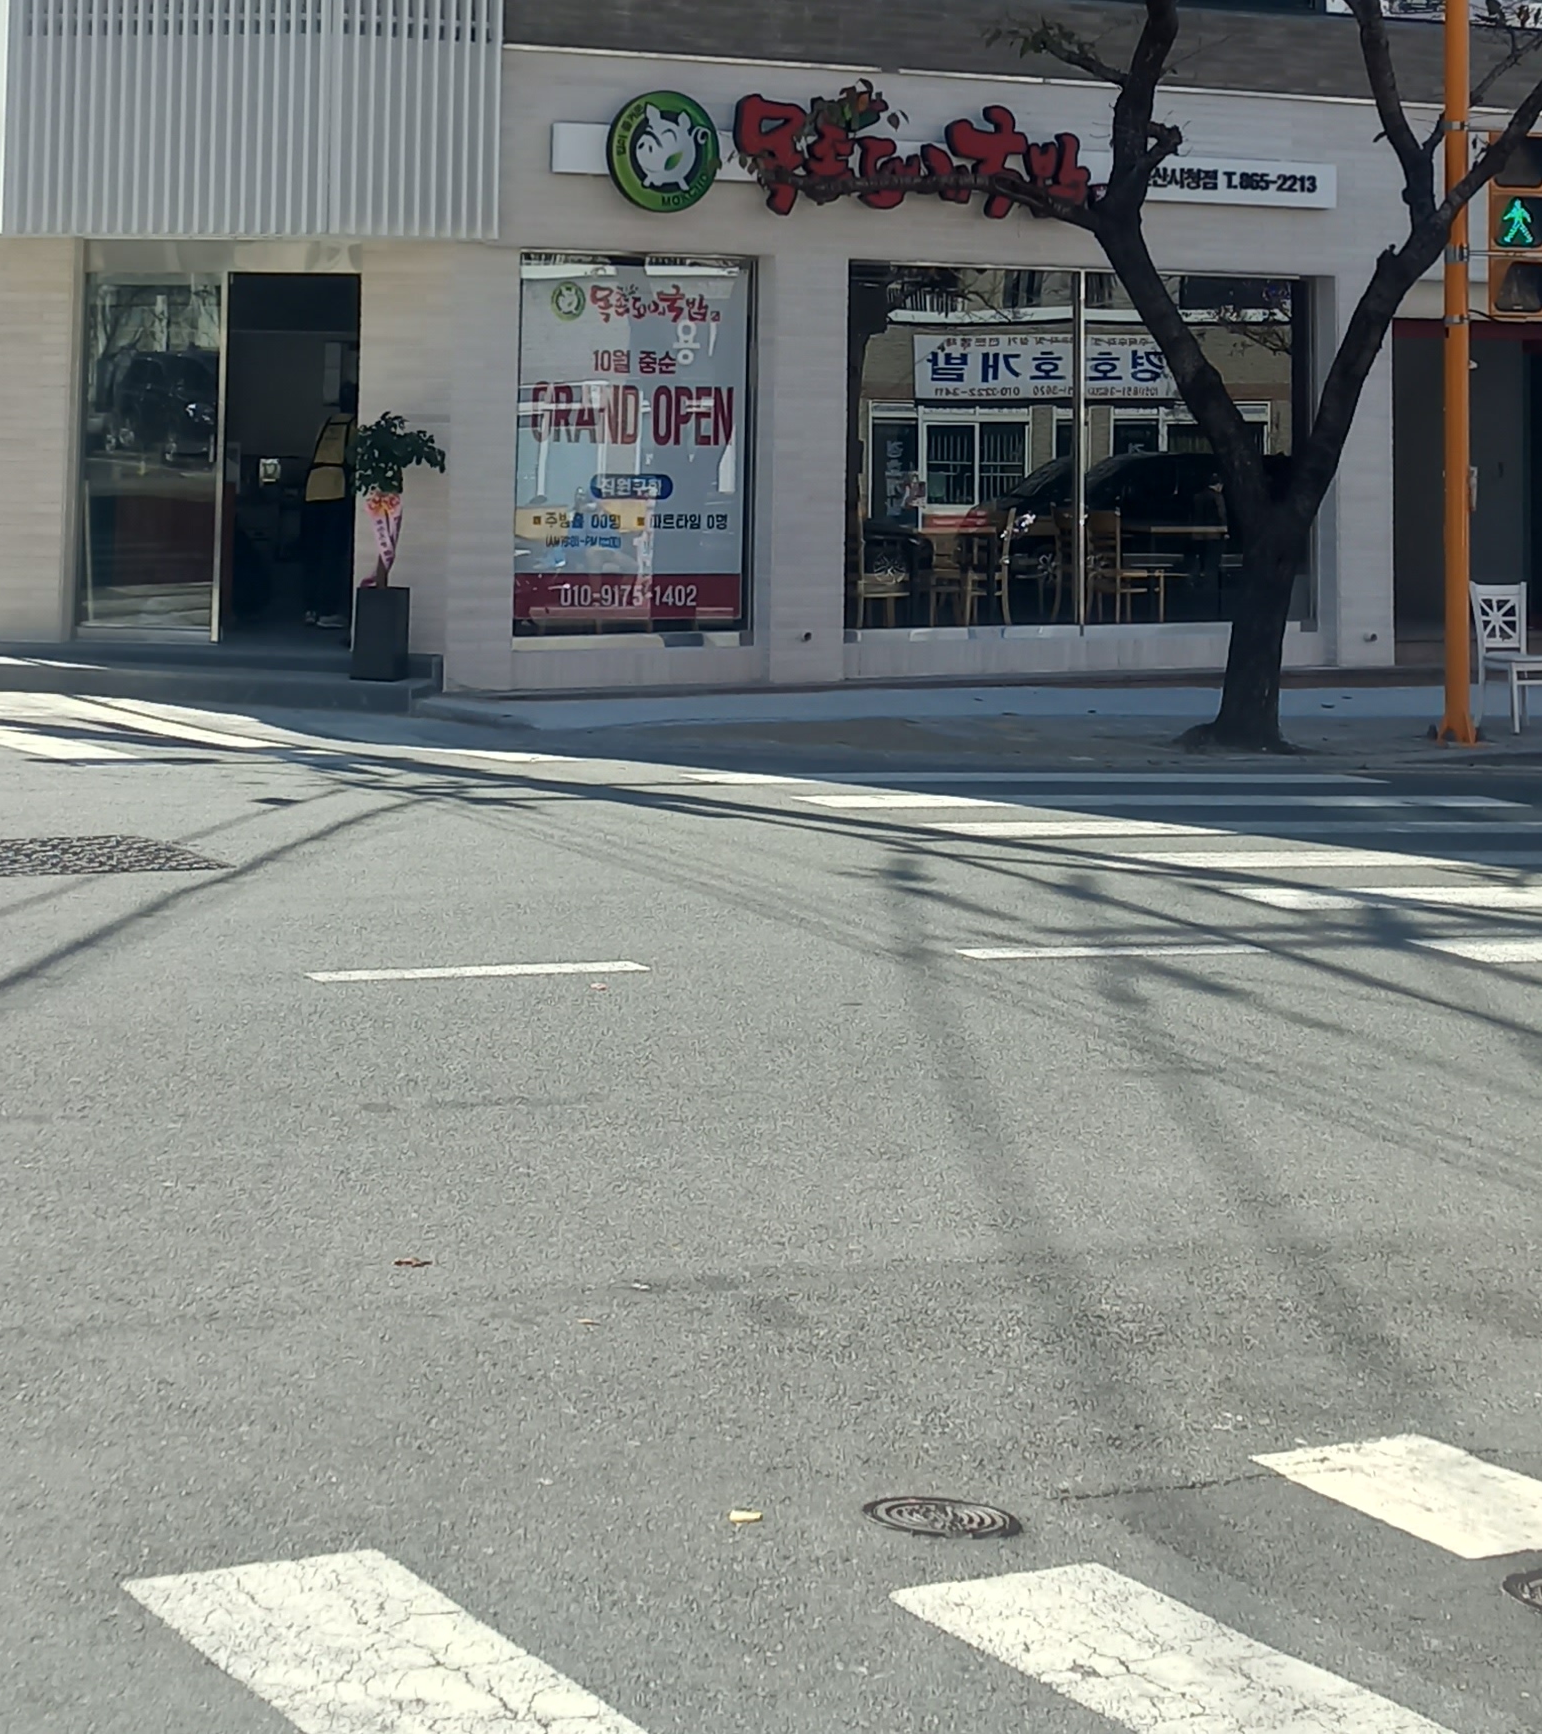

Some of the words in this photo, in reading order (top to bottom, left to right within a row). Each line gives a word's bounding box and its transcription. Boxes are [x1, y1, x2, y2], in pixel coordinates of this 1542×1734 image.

[593, 349, 631, 373] 10월
[639, 350, 677, 375] 중순
[531, 381, 640, 445] GRAND
[652, 384, 734, 446] OPEN
[649, 513, 702, 530] 파트타임
[706, 514, 728, 530] 0명
[559, 584, 698, 607] 010-9175-1402
